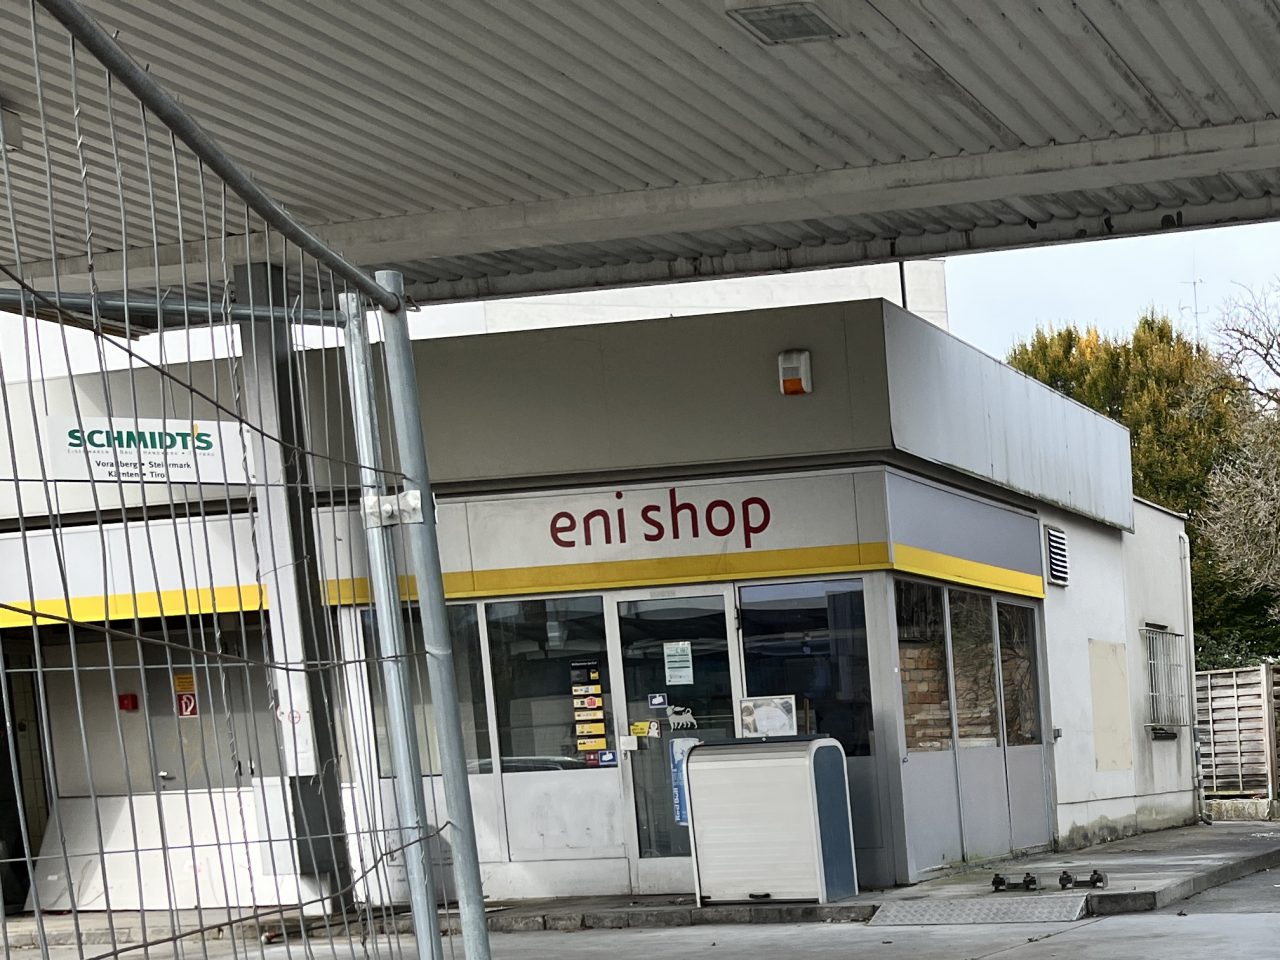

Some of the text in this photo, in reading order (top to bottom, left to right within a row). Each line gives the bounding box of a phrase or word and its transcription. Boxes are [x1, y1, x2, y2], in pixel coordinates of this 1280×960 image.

[95, 460, 191, 469] Voraberg Steirmark
[149, 471, 166, 479] Tiro
[550, 487, 771, 549] eni shop
